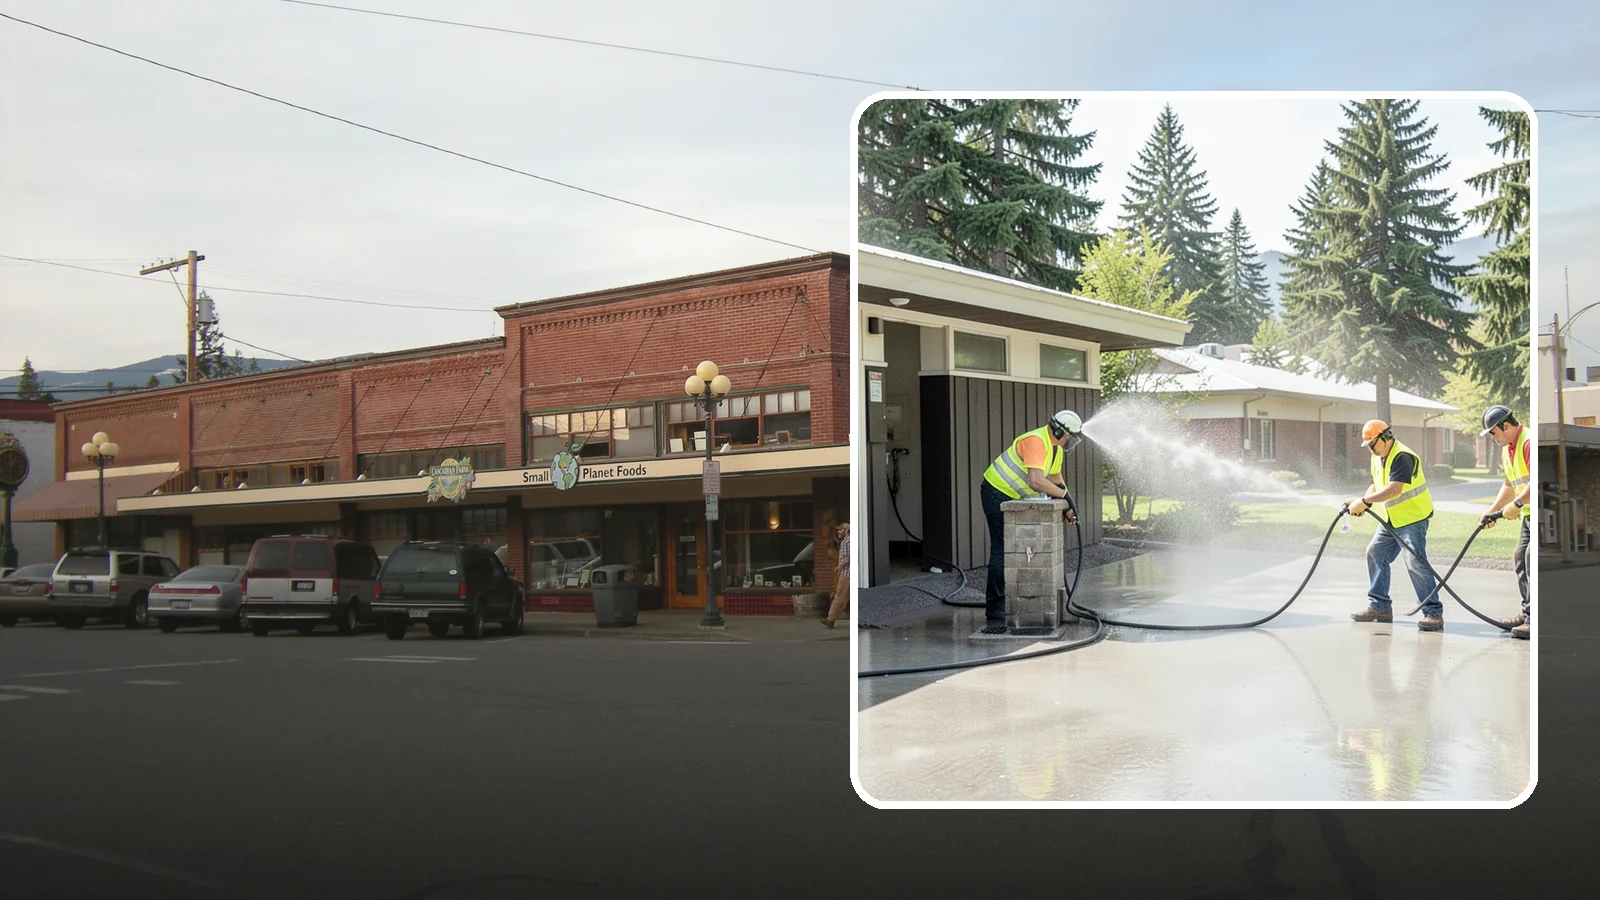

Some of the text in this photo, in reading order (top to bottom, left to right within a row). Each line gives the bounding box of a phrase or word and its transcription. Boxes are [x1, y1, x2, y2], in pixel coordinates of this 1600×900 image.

[523, 464, 647, 483] Small Planet Foods
